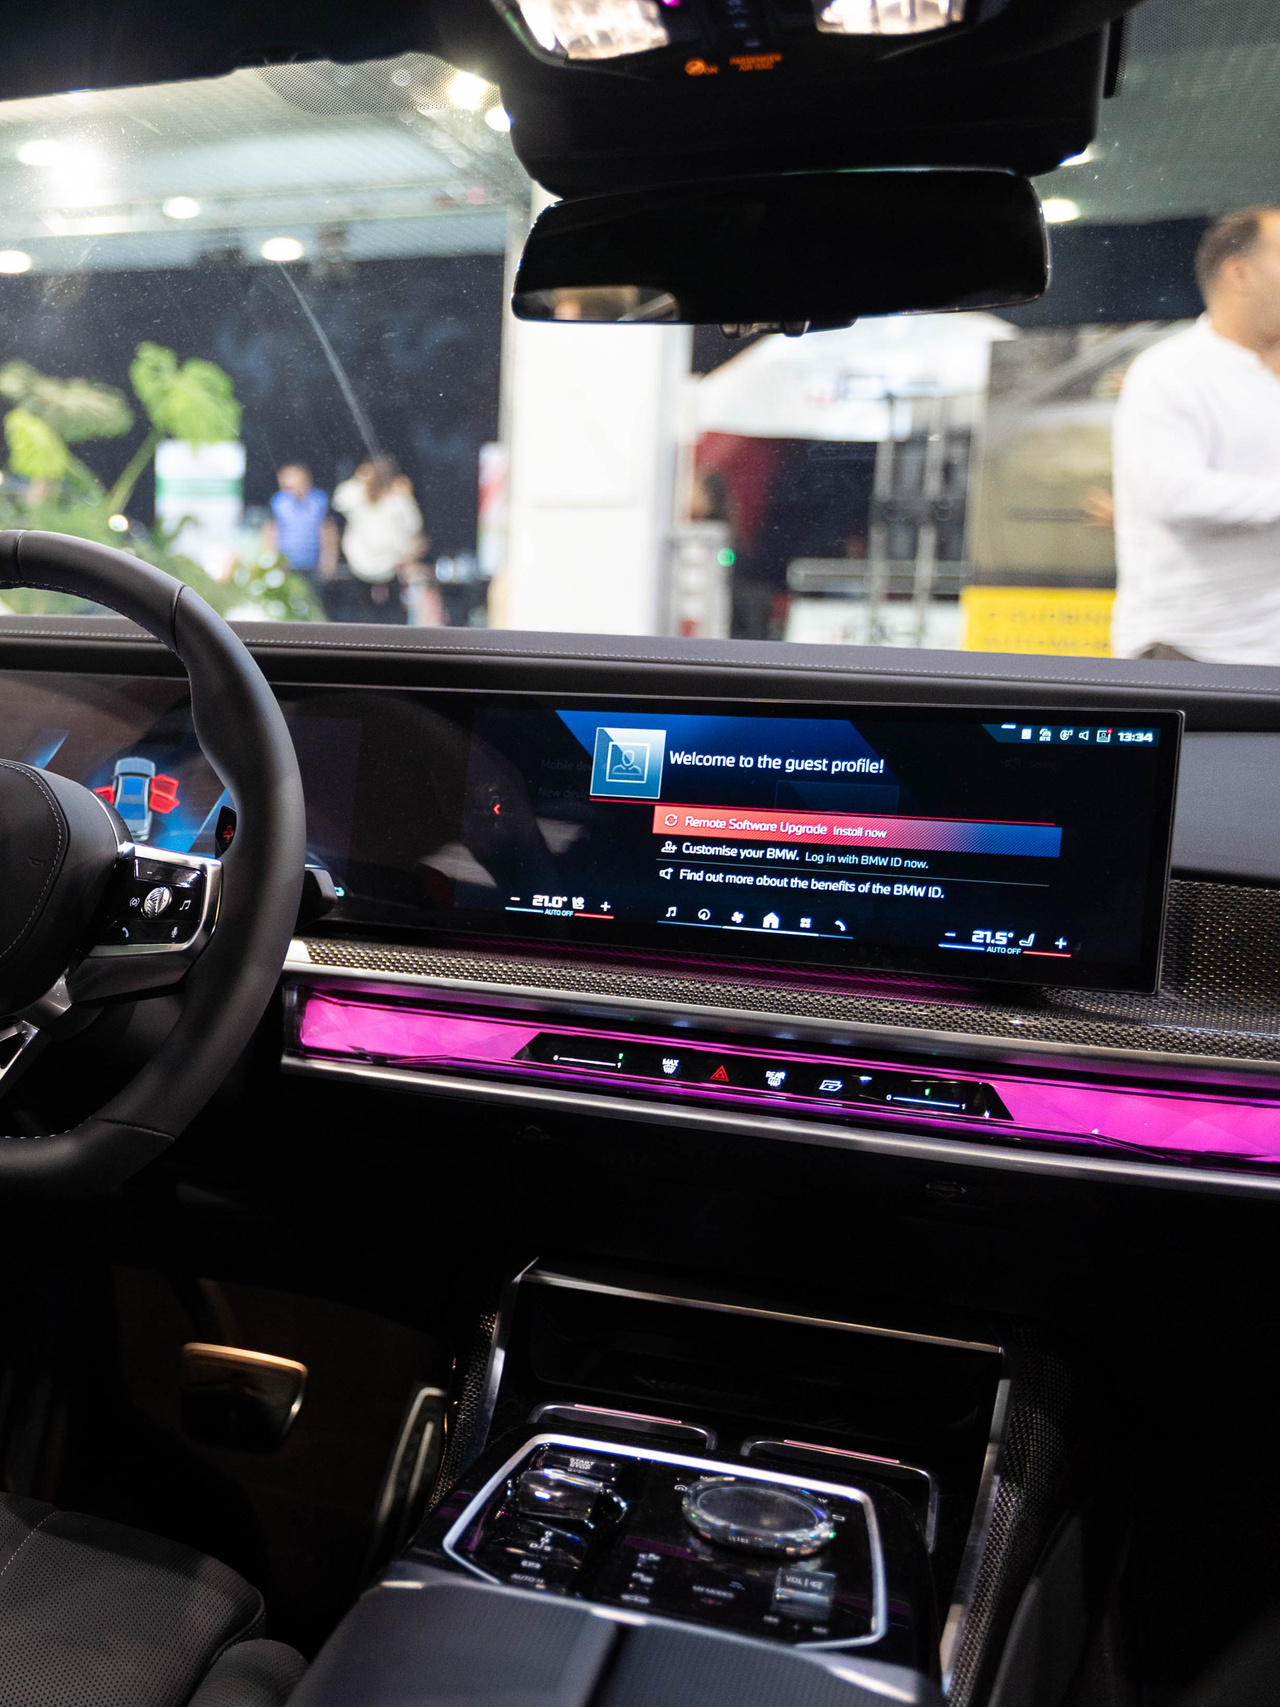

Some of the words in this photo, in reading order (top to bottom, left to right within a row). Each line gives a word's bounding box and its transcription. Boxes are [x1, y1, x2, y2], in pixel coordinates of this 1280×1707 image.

[1117, 731, 1153, 742] 13:34
[669, 750, 735, 767] Welcome
[739, 755, 754, 768] to
[757, 754, 782, 769] the
[785, 758, 828, 773] guest
[831, 758, 884, 774] profile!
[685, 816, 726, 829] Remote
[729, 818, 777, 832] Software
[779, 821, 828, 836] Upgrade
[833, 825, 863, 837] Install
[864, 829, 887, 838] now
[682, 842, 737, 858] Customise
[739, 847, 764, 859] your
[766, 848, 799, 861] BMW.
[805, 852, 824, 864] Log
[826, 853, 835, 863] in
[837, 854, 858, 865] with
[861, 855, 889, 867] BMW
[890, 857, 902, 867] ID
[904, 859, 929, 869] now.
[679, 869, 704, 882] Find
[705, 872, 724, 883] out
[725, 874, 754, 885] more
[756, 875, 788, 888] about
[790, 877, 809, 889] the
[810, 879, 855, 893] benefits
[858, 881, 871, 894] of
[872, 883, 891, 895] the
[893, 885, 926, 897] BMW
[928, 886, 945, 899] ID.
[544, 908, 561, 916] AUTO
[986, 946, 1006, 954] AUTO
[662, 1058, 679, 1067] MAX
[766, 1070, 786, 1080] REAR
[786, 1575, 803, 1585] VOL
